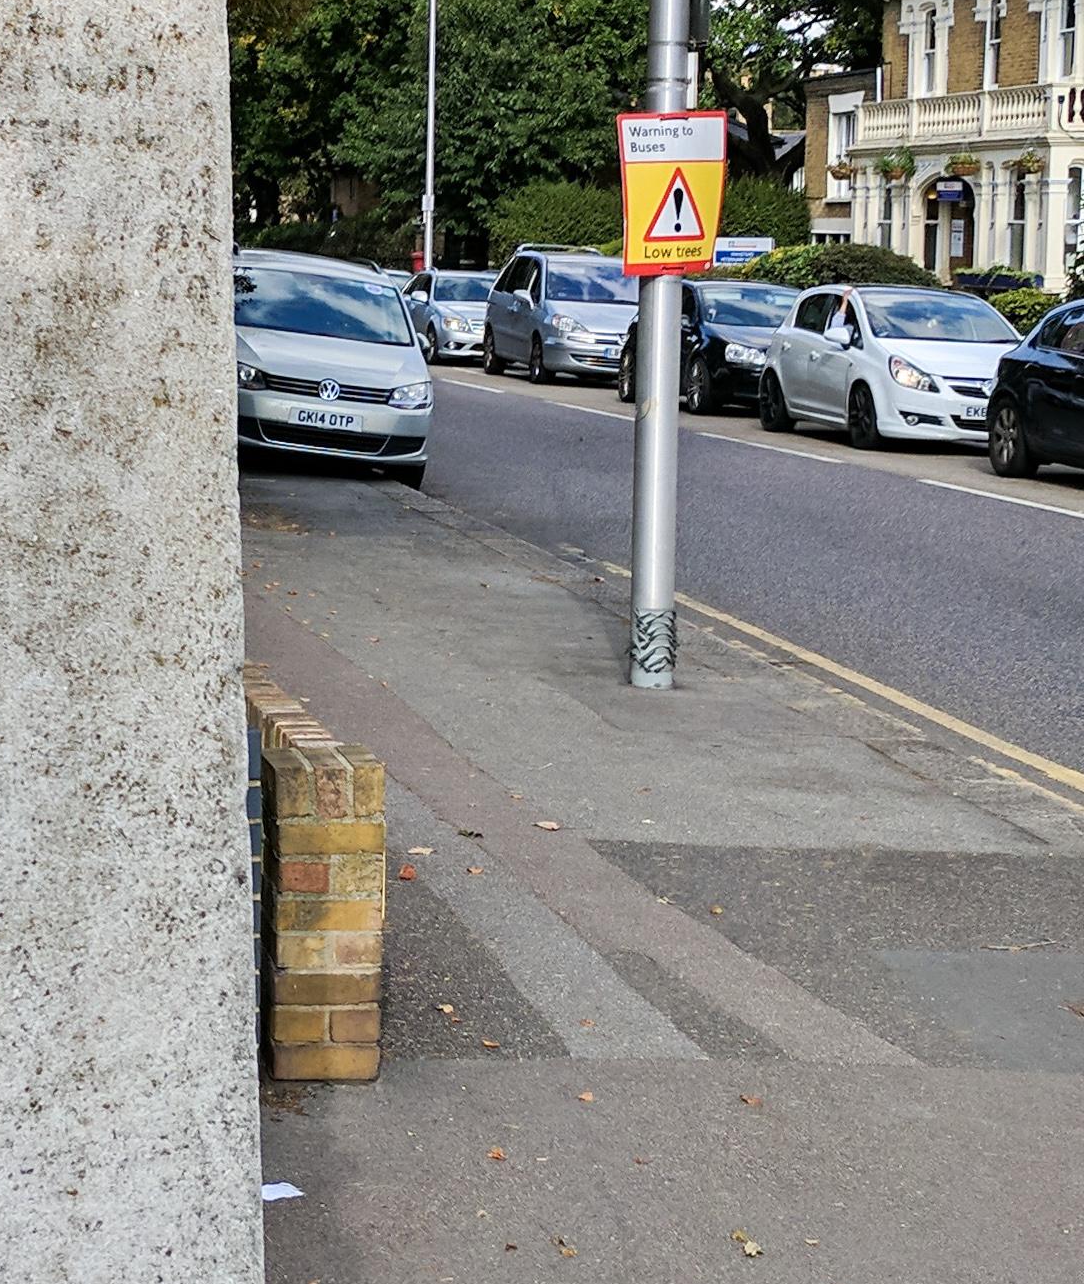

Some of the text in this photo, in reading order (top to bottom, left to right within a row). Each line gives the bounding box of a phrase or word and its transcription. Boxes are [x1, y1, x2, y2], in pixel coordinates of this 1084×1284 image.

[629, 126, 693, 139] Warning to
[630, 142, 666, 153] Buses
[644, 246, 702, 259] Low trees
[298, 410, 354, 427] GK14 OTP
